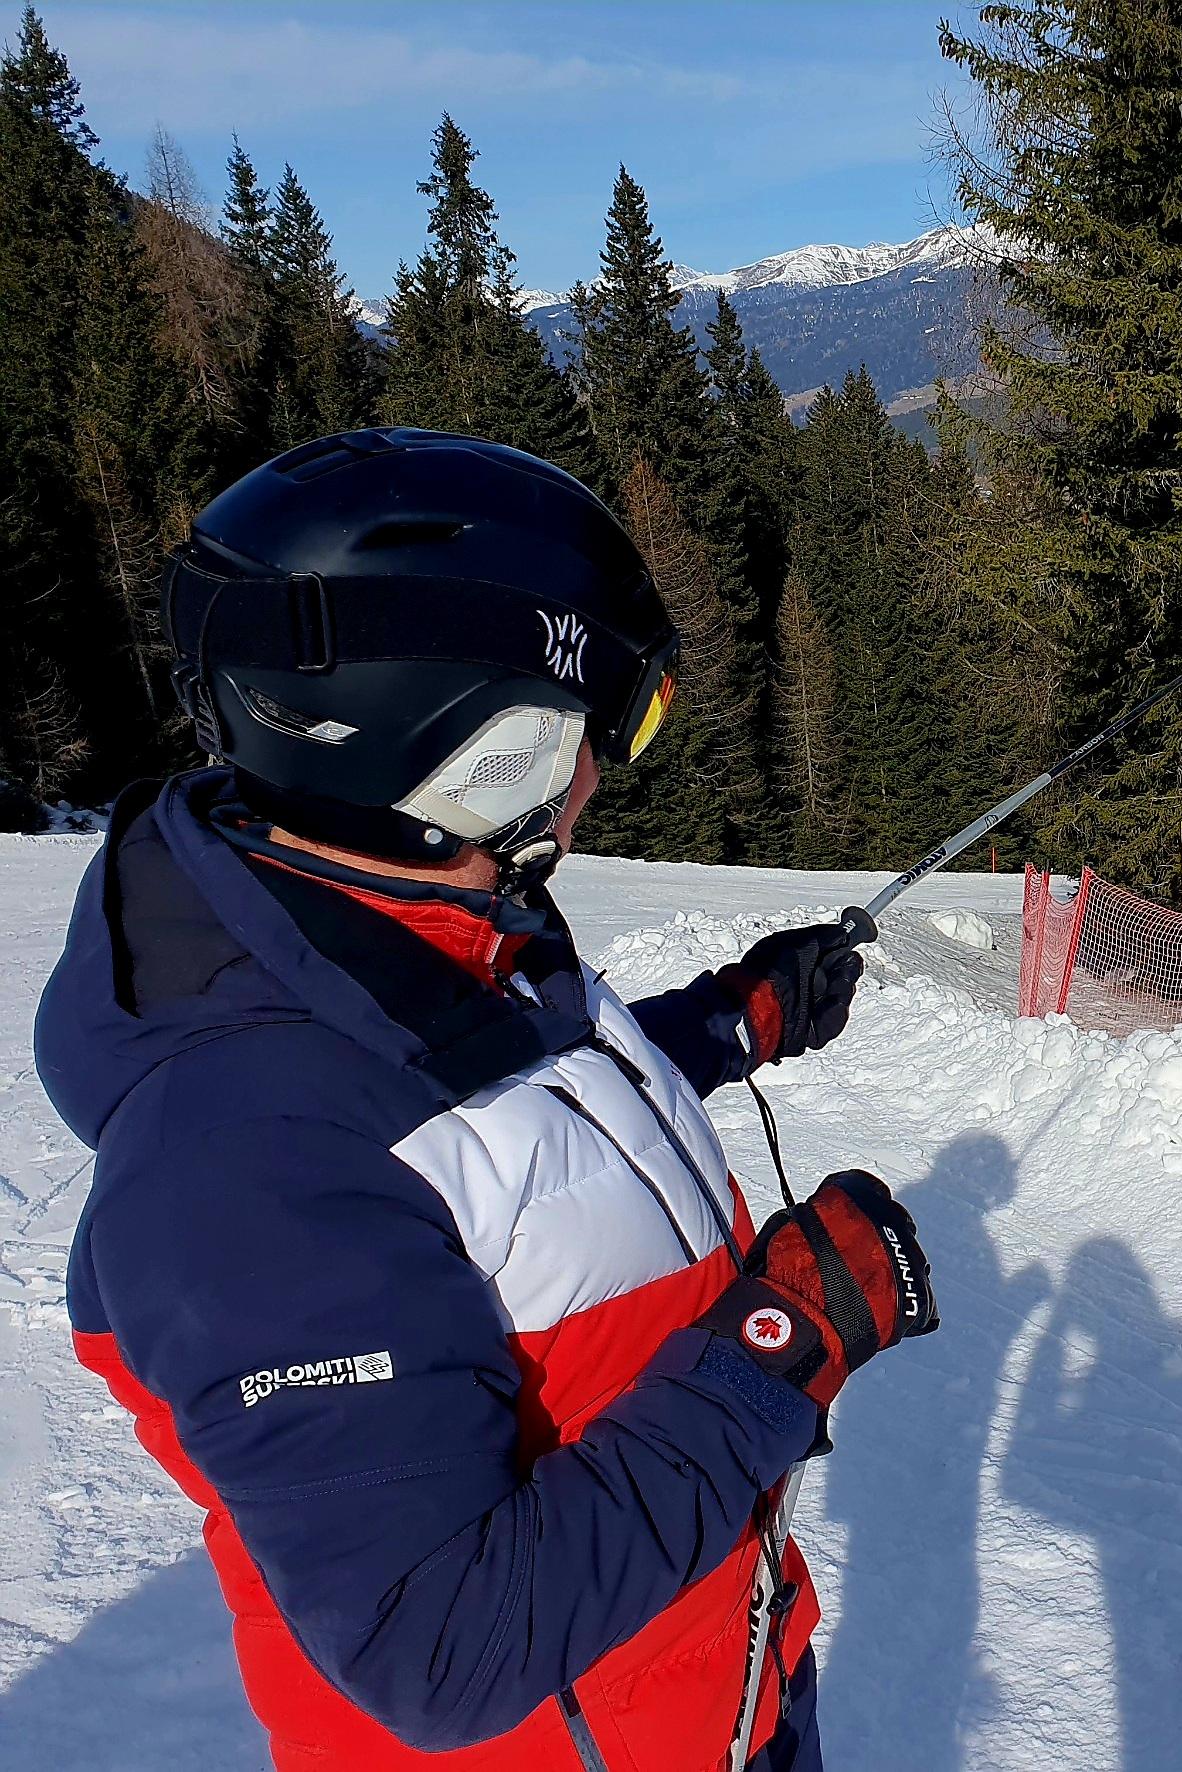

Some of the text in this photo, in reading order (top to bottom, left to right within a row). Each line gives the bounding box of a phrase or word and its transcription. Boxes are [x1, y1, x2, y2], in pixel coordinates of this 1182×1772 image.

[899, 846, 948, 886] ATOMIC
[883, 1225, 918, 1317] LI-NING
[239, 1357, 353, 1394] DOLOMITI
